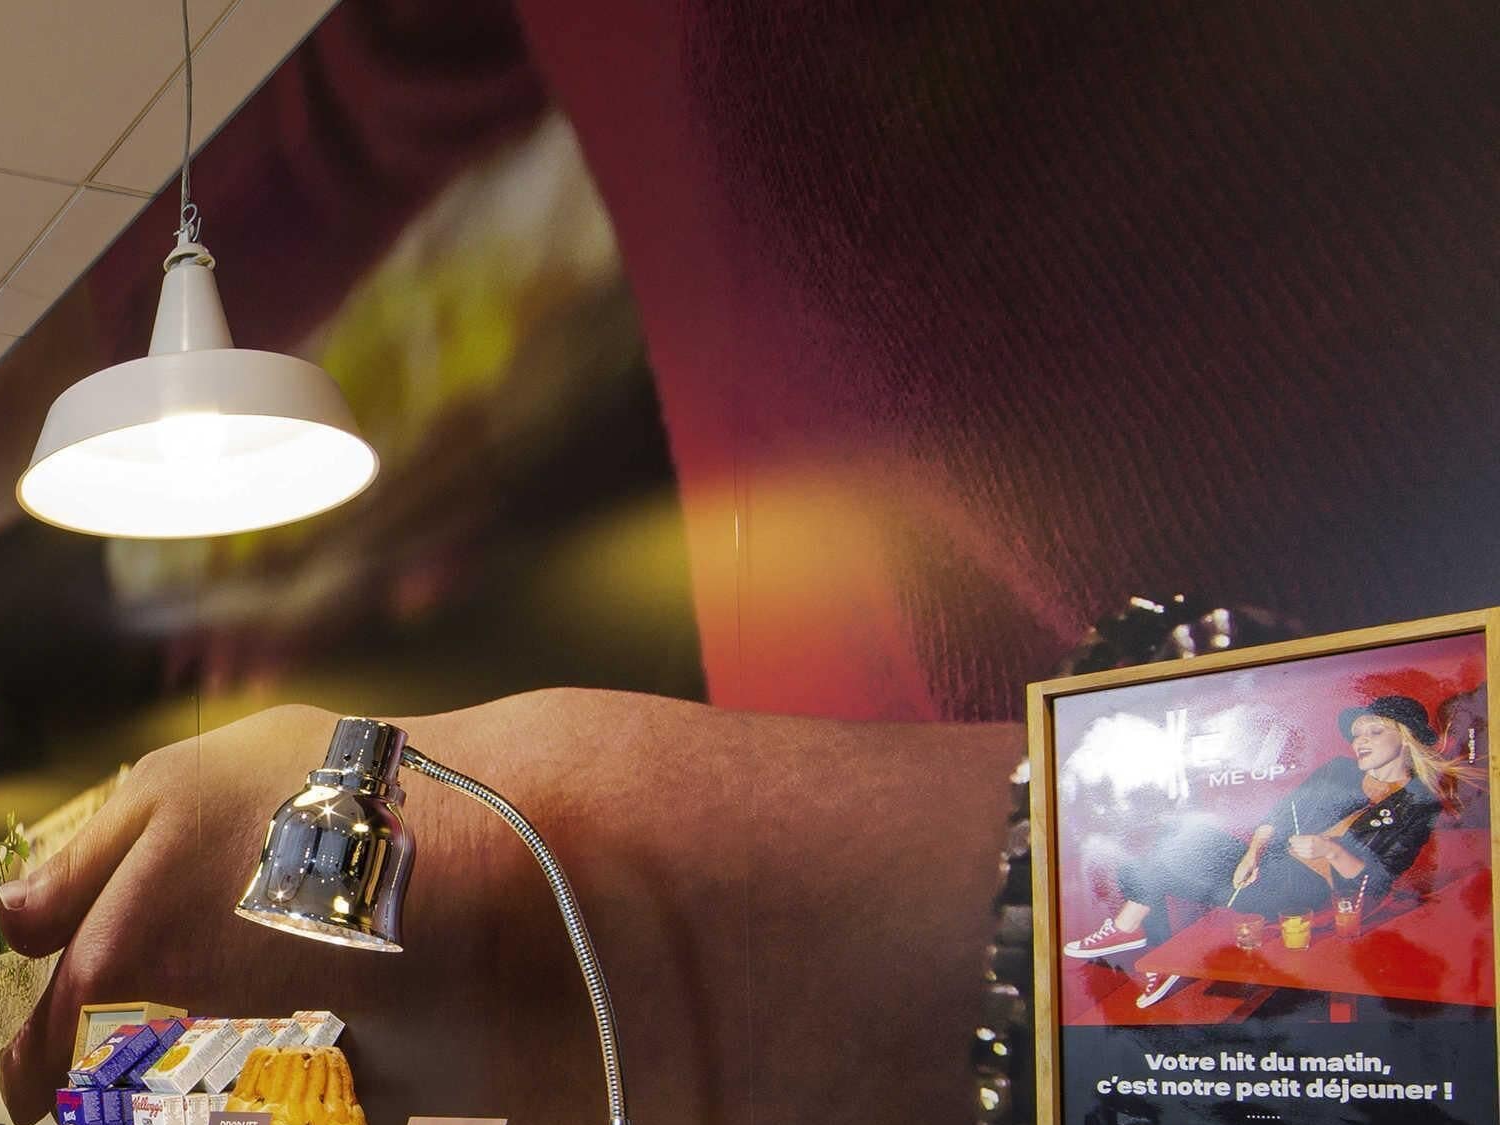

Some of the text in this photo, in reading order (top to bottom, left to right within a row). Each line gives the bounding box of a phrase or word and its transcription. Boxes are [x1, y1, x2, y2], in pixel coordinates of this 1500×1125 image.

[1144, 1051, 1391, 1076] Votre hit du matin,
[1096, 1075, 1453, 1104] c'est notre petit déjeuner !
